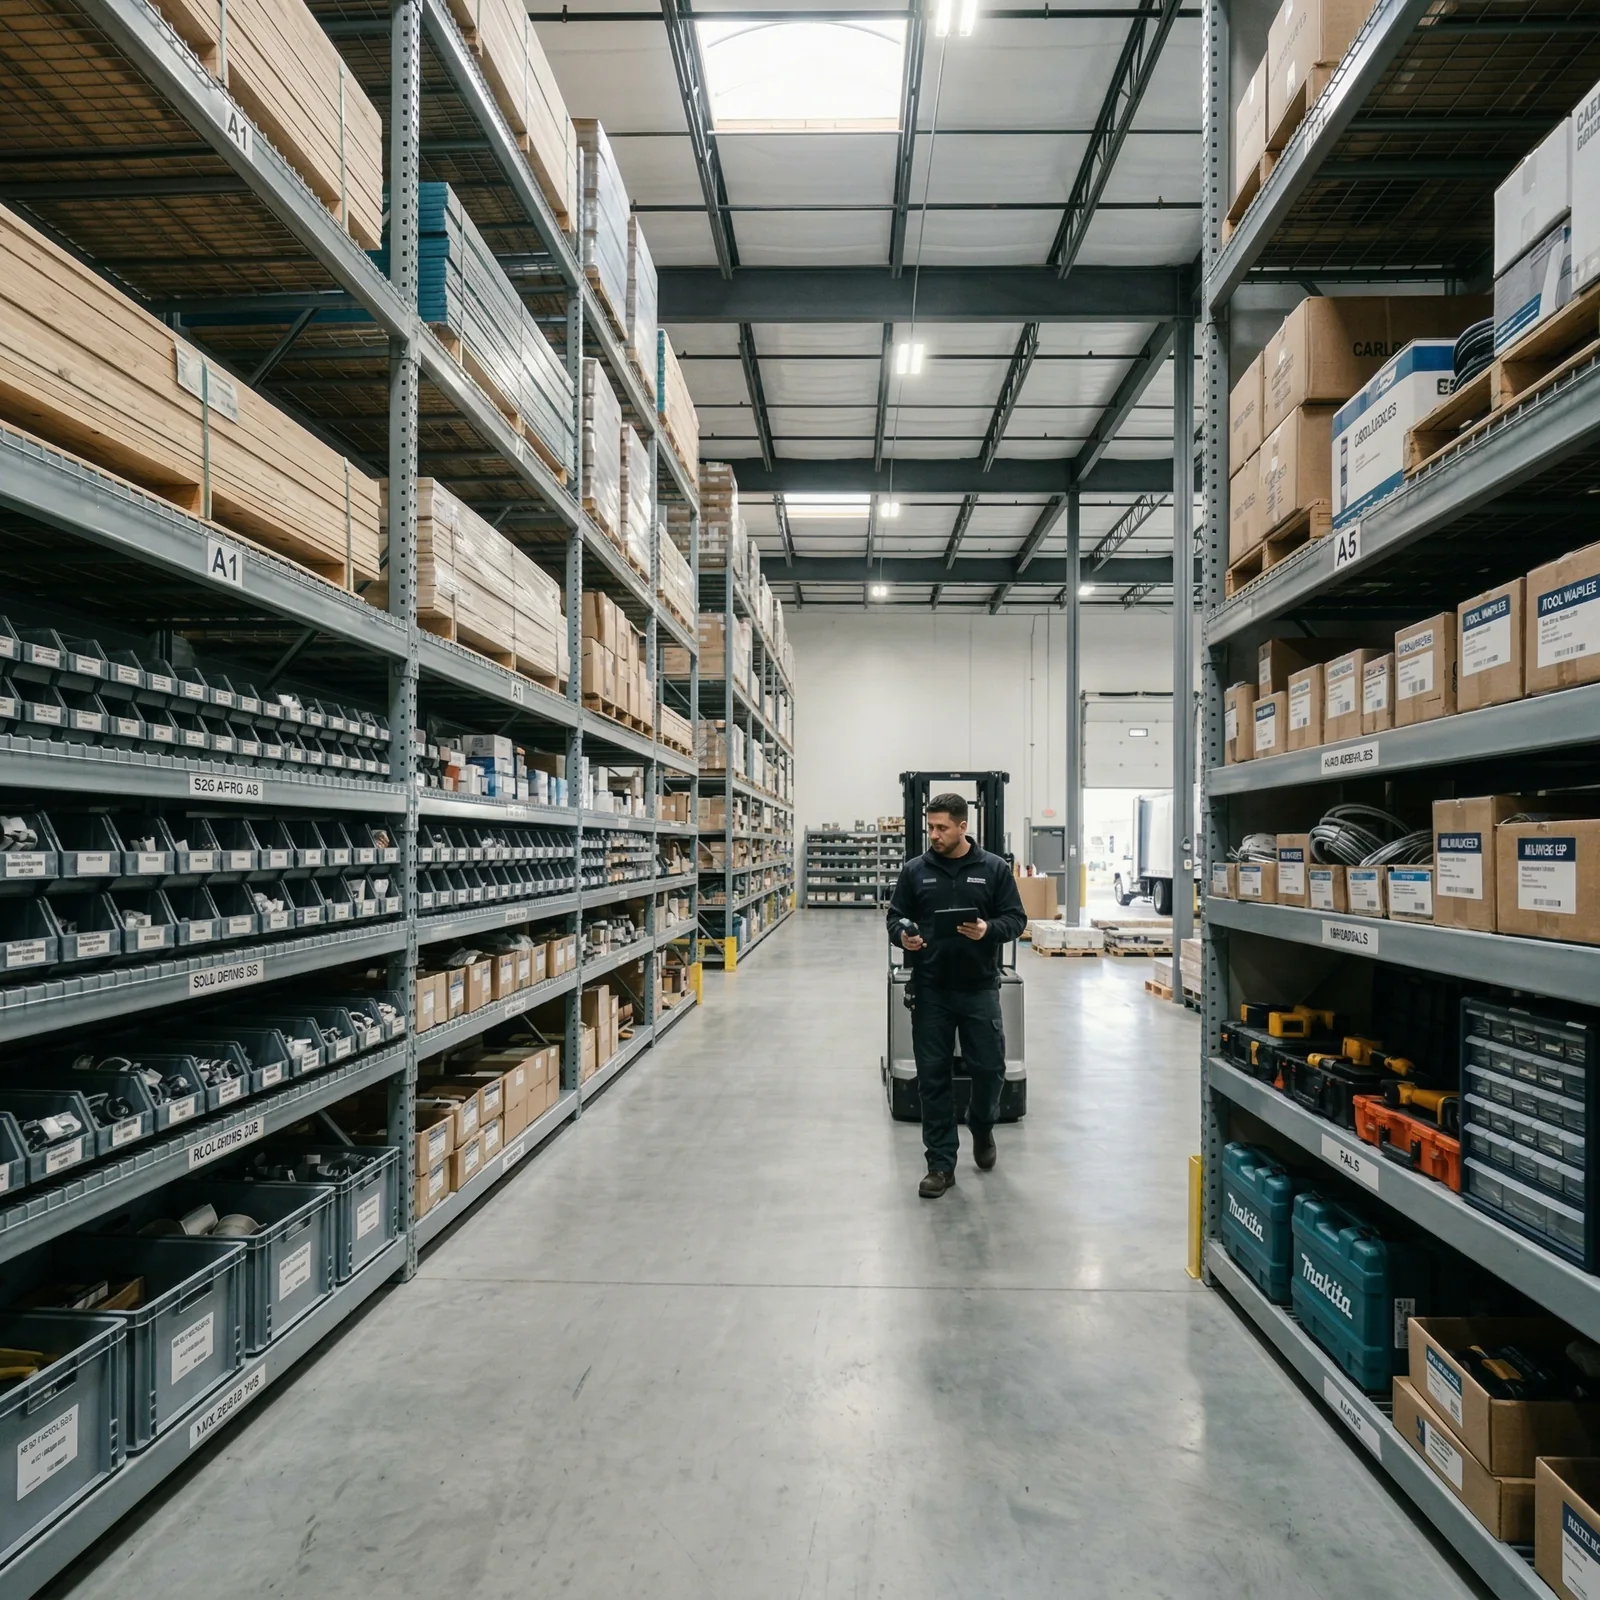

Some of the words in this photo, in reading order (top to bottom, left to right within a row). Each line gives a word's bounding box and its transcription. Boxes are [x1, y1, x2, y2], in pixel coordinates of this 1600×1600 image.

[228, 112, 247, 151] A1
[212, 546, 238, 581] A1
[1336, 530, 1356, 567] A5
[512, 684, 522, 701] A1
[194, 778, 215, 792] S26
